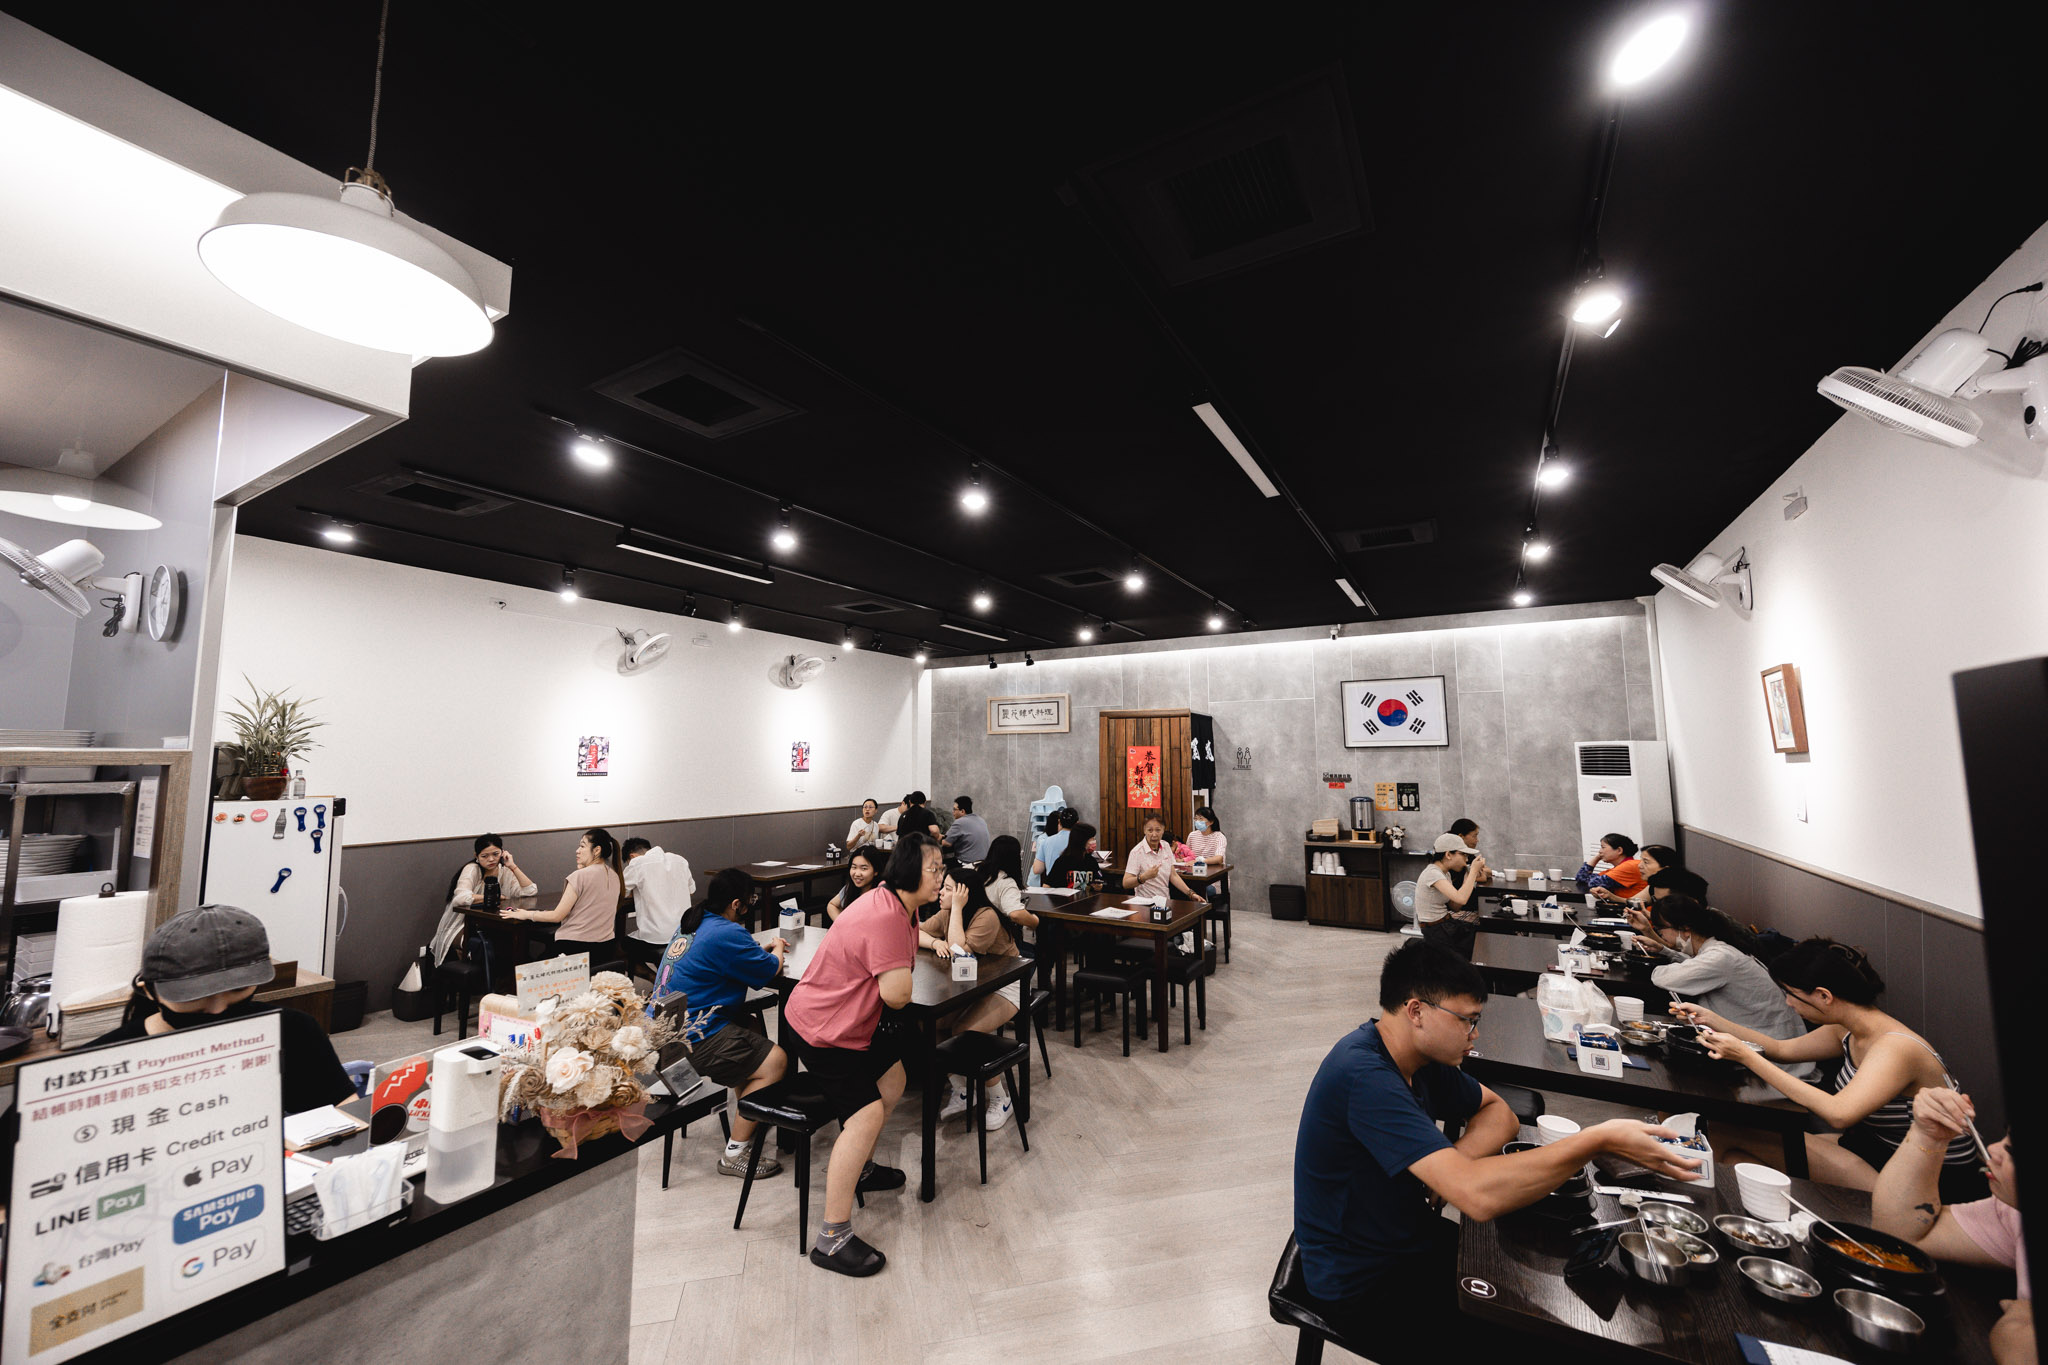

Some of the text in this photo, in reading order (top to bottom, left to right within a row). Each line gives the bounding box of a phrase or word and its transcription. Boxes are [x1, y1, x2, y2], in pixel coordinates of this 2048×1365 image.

[1144, 750, 1156, 774] 恭賀
[43, 1033, 264, 1092] 付款方式 Payment Method
[111, 1094, 229, 1136] 現金 Cash
[75, 1116, 269, 1185] 信用卡 Credit card
[211, 1154, 254, 1179] Pay
[35, 1191, 142, 1236] LINE Pay
[182, 1188, 255, 1221] SAMSUNG
[199, 1206, 239, 1231] Pay
[212, 1239, 257, 1267] Pay
